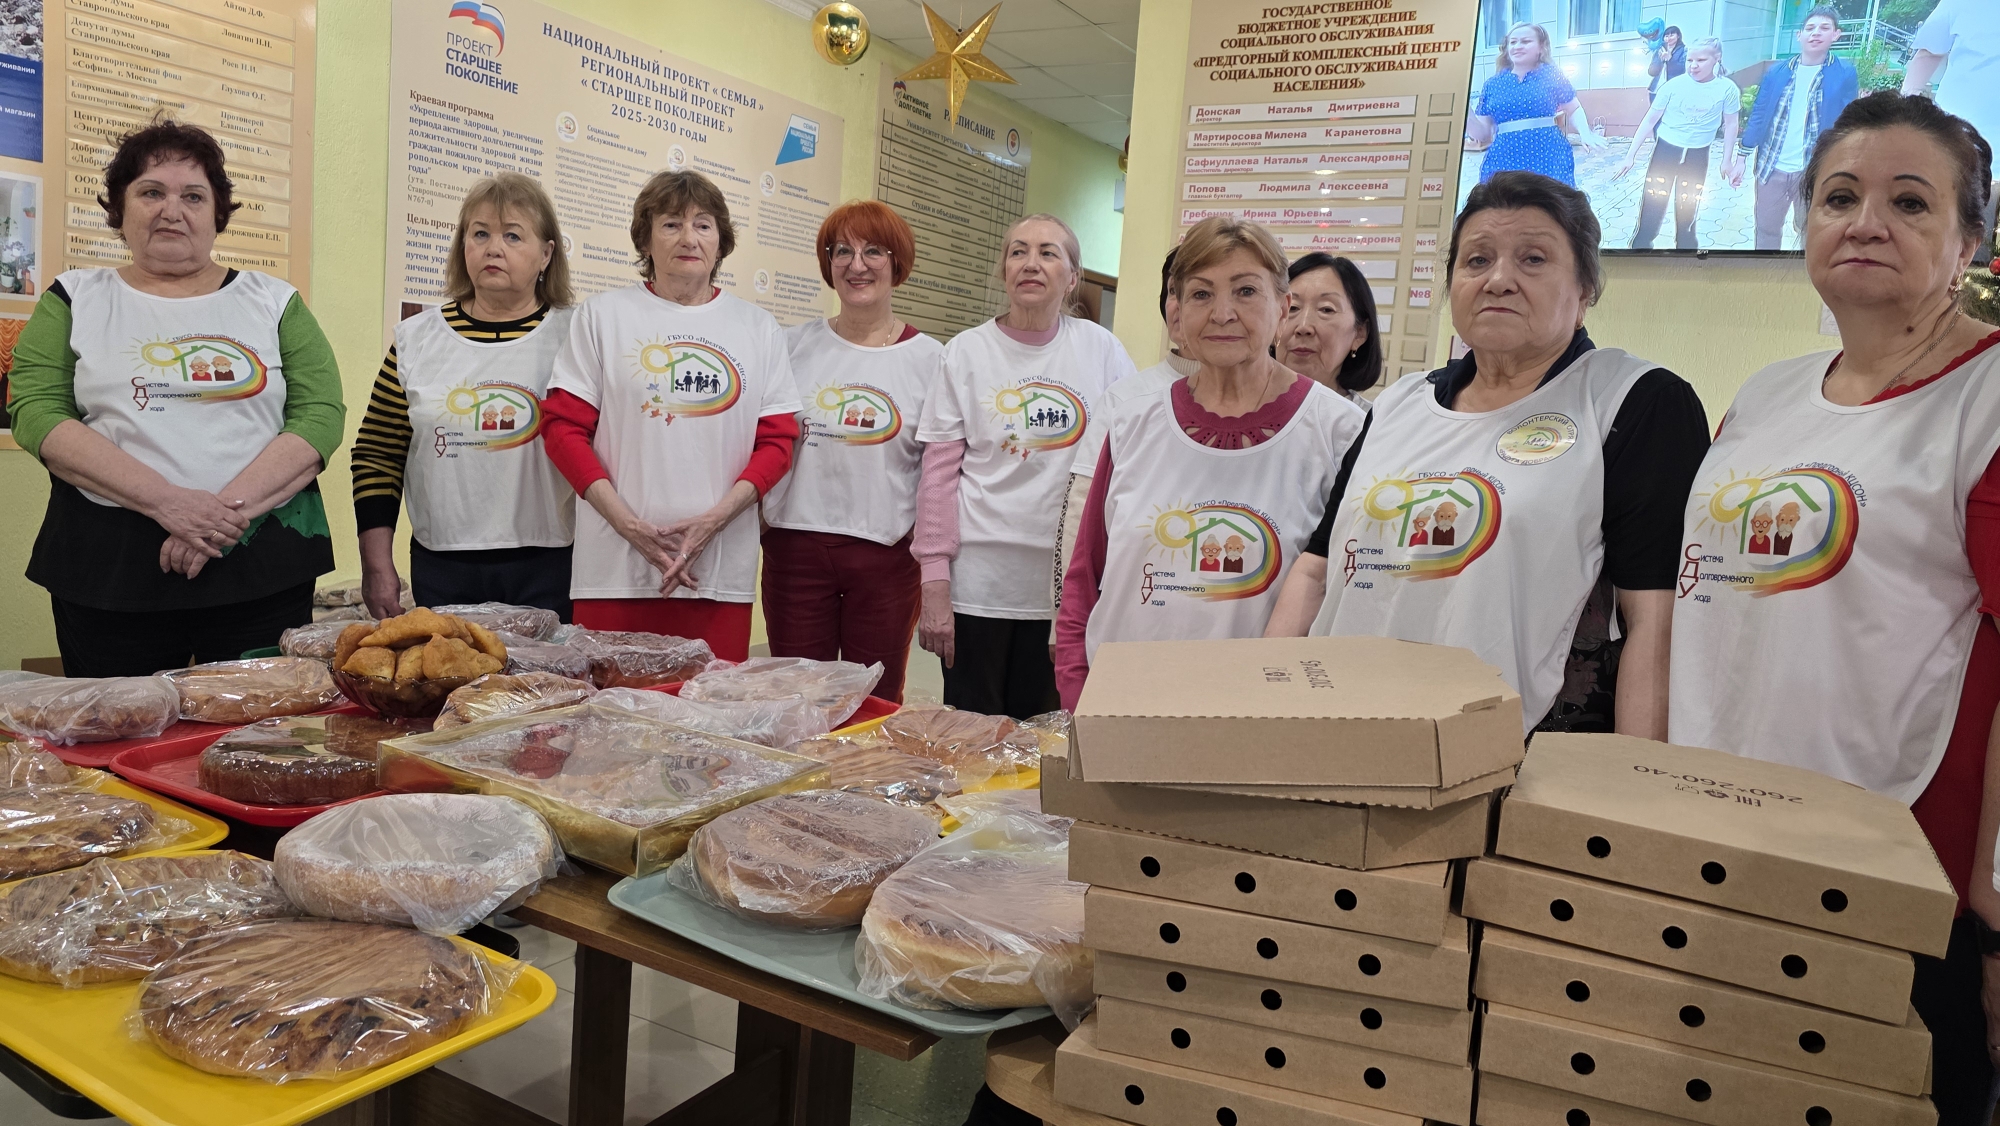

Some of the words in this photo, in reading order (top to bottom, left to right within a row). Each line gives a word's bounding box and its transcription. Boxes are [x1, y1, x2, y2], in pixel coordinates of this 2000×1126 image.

[1262, 0, 1393, 19] ГОСУДАРСТВЕННОЕ
[71, 16, 110, 32] Депутат
[110, 28, 135, 40] думы
[150, 19, 171, 30] края
[1237, 18, 1321, 35] БЮДЖЕТНОЕ
[1324, 10, 1417, 28] УЧРЕЖДЕНИЕ
[71, 28, 149, 53] Ставропольского
[150, 49, 171, 59] края
[446, 31, 494, 57] ПРОЕКТ
[1220, 31, 1317, 49] СОЦИАЛЬНОГО
[1319, 23, 1435, 42] ОБСЛУЖИВАНИЯ
[73, 47, 161, 76] Благотворительный
[162, 70, 182, 82] фонд
[445, 47, 503, 76] СТАРШЕЕ
[1193, 48, 1291, 68] «ПРЕДГОРНЫЙ
[1293, 42, 1408, 62] КОМПЛЕКСНЫЙ
[1410, 41, 1461, 55] ЦЕНТР
[72, 60, 113, 75] «София»
[125, 72, 158, 86] Москва
[542, 22, 660, 76] НАЦИОНАЛЬНЫЙ
[663, 65, 711, 93] ПРОЕКТ
[720, 87, 758, 110] СЕМЬЯ
[1210, 65, 1312, 82] СОЦИАЛЬНОГО
[1314, 58, 1438, 77] ОБСЛУЖИВАНИЯ
[445, 62, 519, 95] ПОКОЛЕНИЕ
[581, 55, 688, 103] РЕГИОНАЛЬНЫЙ
[691, 93, 736, 118] ПРОЕКТ
[1273, 78, 1366, 94] НАСЕЛЕНИЯ»
[221, 83, 250, 98] Глухова
[903, 92, 929, 109] АКТИВНОЕ
[4, 106, 36, 118] магазин
[409, 89, 447, 108] Краевая
[447, 101, 494, 121] программа
[591, 78, 652, 108] СТАРШЕЕ
[654, 98, 725, 133] ПОКОЛЕНИЕ
[898, 100, 932, 120] ДОЛГОЛЕТИЕ
[1196, 108, 1241, 117] Донская
[1267, 105, 1313, 114] Наталья
[1328, 101, 1400, 113] Дмитриевна
[73, 110, 104, 126] Центр
[409, 103, 461, 124] «Укрепление
[502, 128, 544, 146] увеличение
[611, 103, 677, 135] 2025-2030
[679, 126, 708, 144] годы
[943, 108, 996, 140] РПИСАНИЕ
[409, 115, 442, 131] периода
[442, 124, 482, 141] активного
[482, 135, 524, 152] долголетия
[1194, 132, 1262, 143] Мартиросова
[1264, 131, 1307, 140] Милена
[220, 138, 255, 154] Борисова
[408, 127, 478, 151] должительности
[480, 146, 517, 161] здоровой
[519, 155, 543, 167] жизни
[408, 140, 443, 154] граждан
[445, 148, 483, 165] пожилого
[484, 157, 516, 172] возраста
[408, 152, 459, 170] ропольском
[462, 164, 481, 175] крае
[484, 169, 494, 178] на
[1187, 158, 1259, 170] Сафиуллаева
[1263, 156, 1308, 165] Наталья
[1319, 153, 1410, 164] Александровна
[74, 174, 98, 186] ООО
[1188, 185, 1226, 193] Попова
[1258, 183, 1311, 193] Людмила
[1318, 181, 1389, 191] Алексеевна
[1422, 183, 1442, 192] №2
[407, 184, 461, 202] Ставропольского
[407, 212, 430, 225] Цель
[1243, 209, 1277, 219] Ирина
[1283, 208, 1333, 218] Юрьевна
[406, 226, 452, 242] Улучшение
[1312, 235, 1401, 245] Александровна
[1416, 238, 1437, 247] №15
[406, 239, 432, 250] жизни
[405, 250, 429, 262] путем
[405, 263, 439, 275] личения
[1413, 265, 1434, 274] №11
[404, 275, 428, 285] летия
[1410, 289, 1431, 299] №8
[667, 334, 694, 342] ГБУСО
[695, 337, 737, 364] «Предгорный
[1018, 374, 1042, 386] ГБУСО
[1418, 471, 1447, 479] ГБУСО
[1844, 473, 1868, 508] КЦСОН»
[1193, 499, 1217, 509] ГБУСО
[1218, 499, 1261, 517] «Предгорный
[1260, 511, 1281, 536] КЦСОН»
[1344, 539, 1384, 555] Система
[1684, 543, 1724, 564] Система
[1143, 562, 1176, 578] Система
[1343, 553, 1411, 574] Долговременного
[1678, 560, 1755, 585] Долговременного
[1141, 575, 1206, 594] Долговременного
[1677, 581, 1712, 604] Ухода
